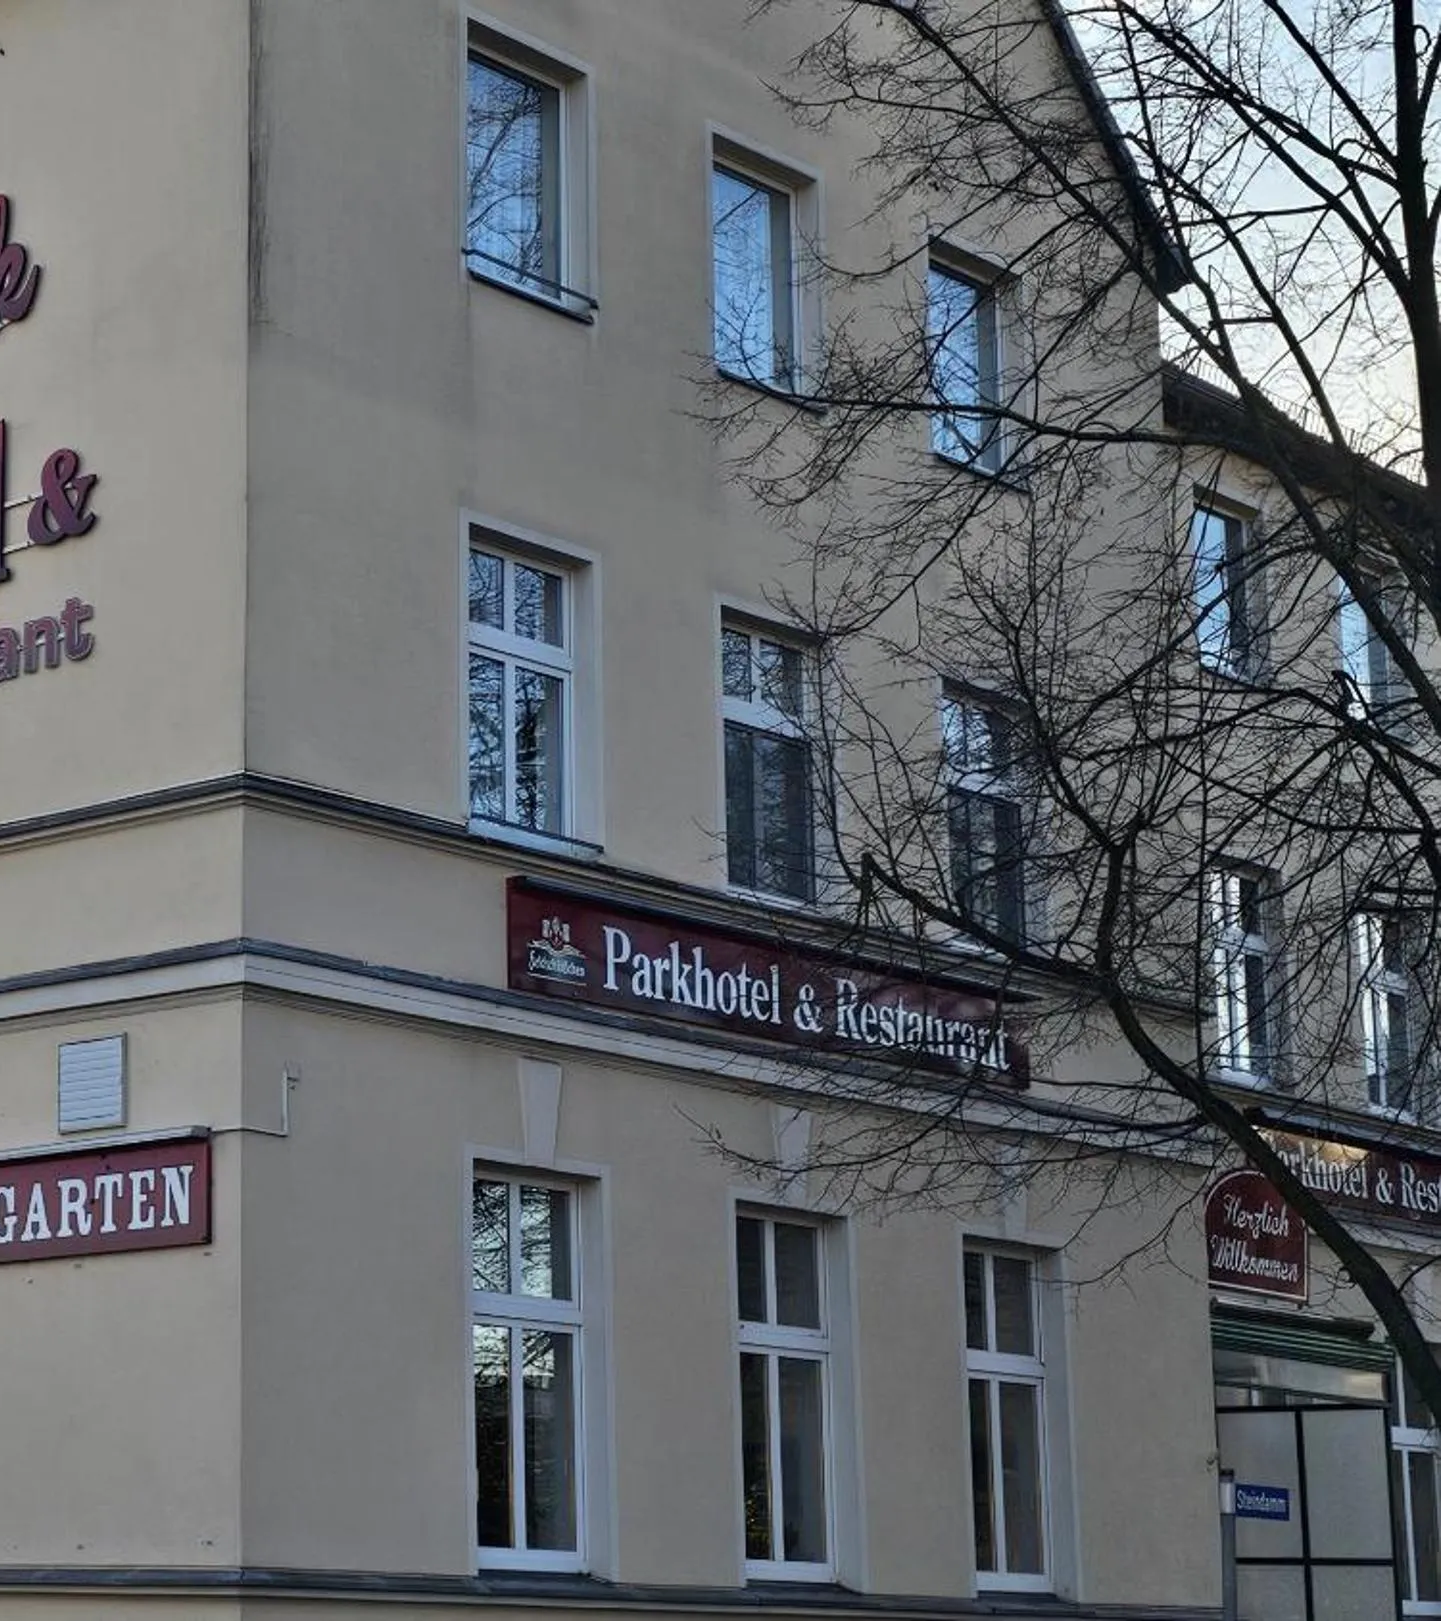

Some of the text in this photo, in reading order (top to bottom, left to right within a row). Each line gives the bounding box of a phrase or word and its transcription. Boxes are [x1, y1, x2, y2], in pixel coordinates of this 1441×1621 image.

[26, 447, 98, 547] &
[602, 925, 1011, 1070] Parkhotel & Restaurant
[1375, 1166, 1393, 1205] &
[1222, 1193, 1289, 1239] Herzlich
[1210, 1234, 1298, 1283] Willkommen
